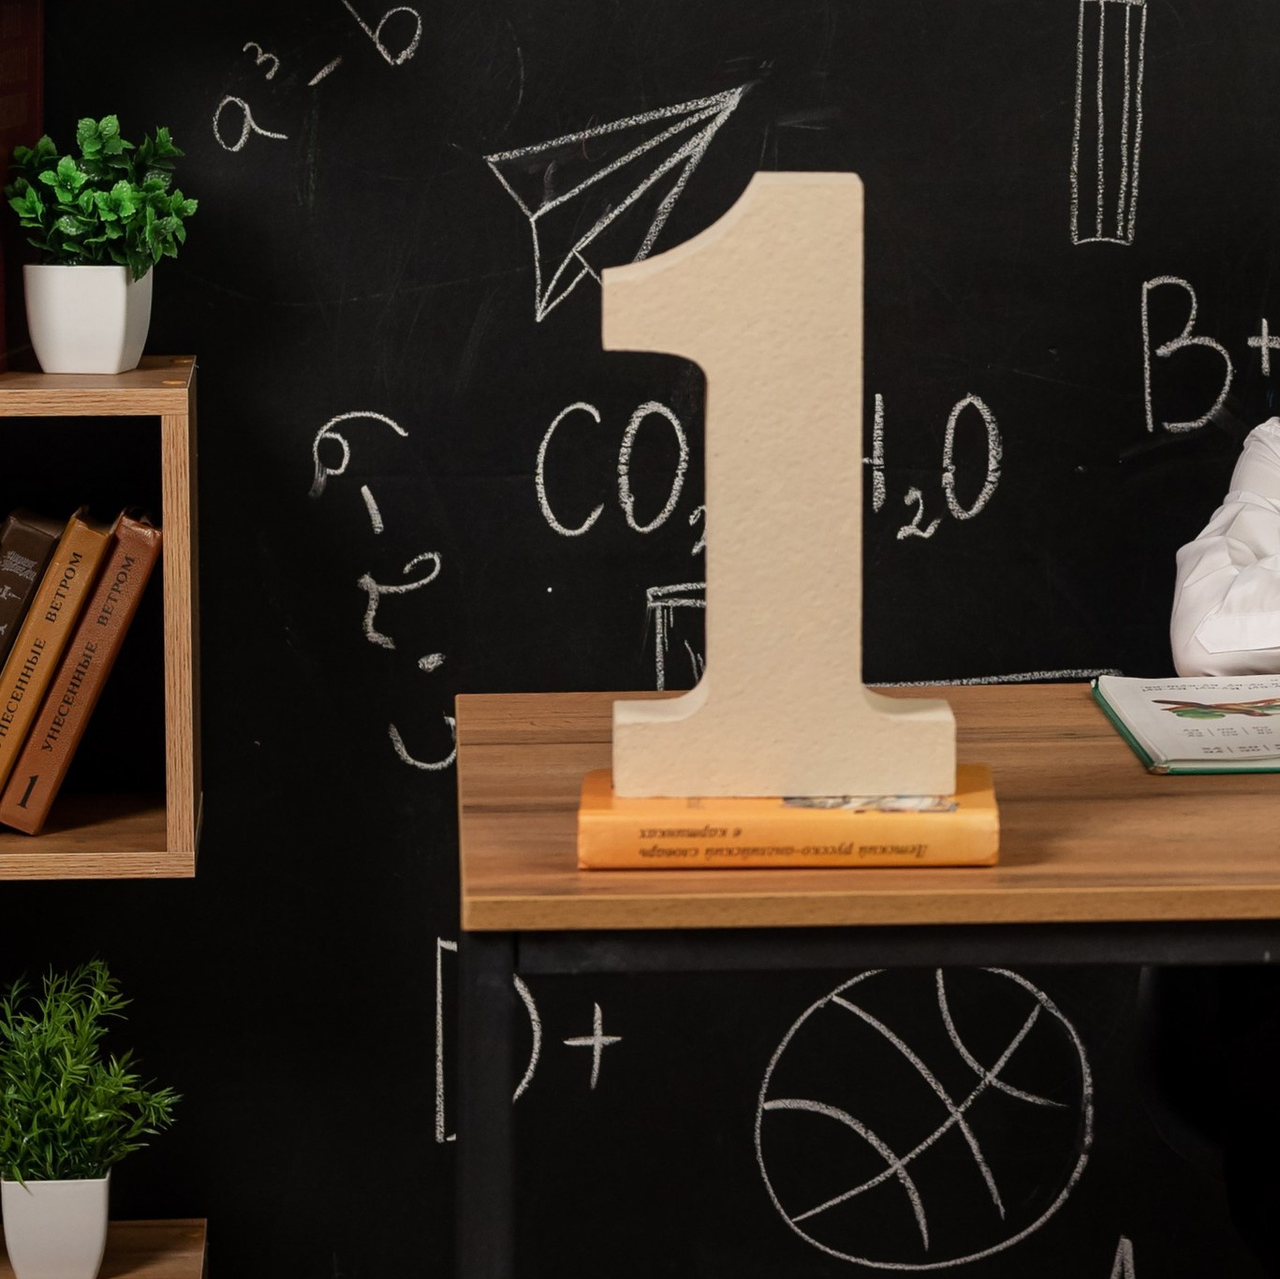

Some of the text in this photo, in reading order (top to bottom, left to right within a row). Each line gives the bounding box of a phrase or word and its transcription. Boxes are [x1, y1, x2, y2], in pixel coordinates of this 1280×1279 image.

[45, 551, 83, 624] ВЕТРОМ
[41, 555, 136, 753] УНЕСЕННЫЕ ВЕТРОМ
[16, 774, 39, 810] 1
